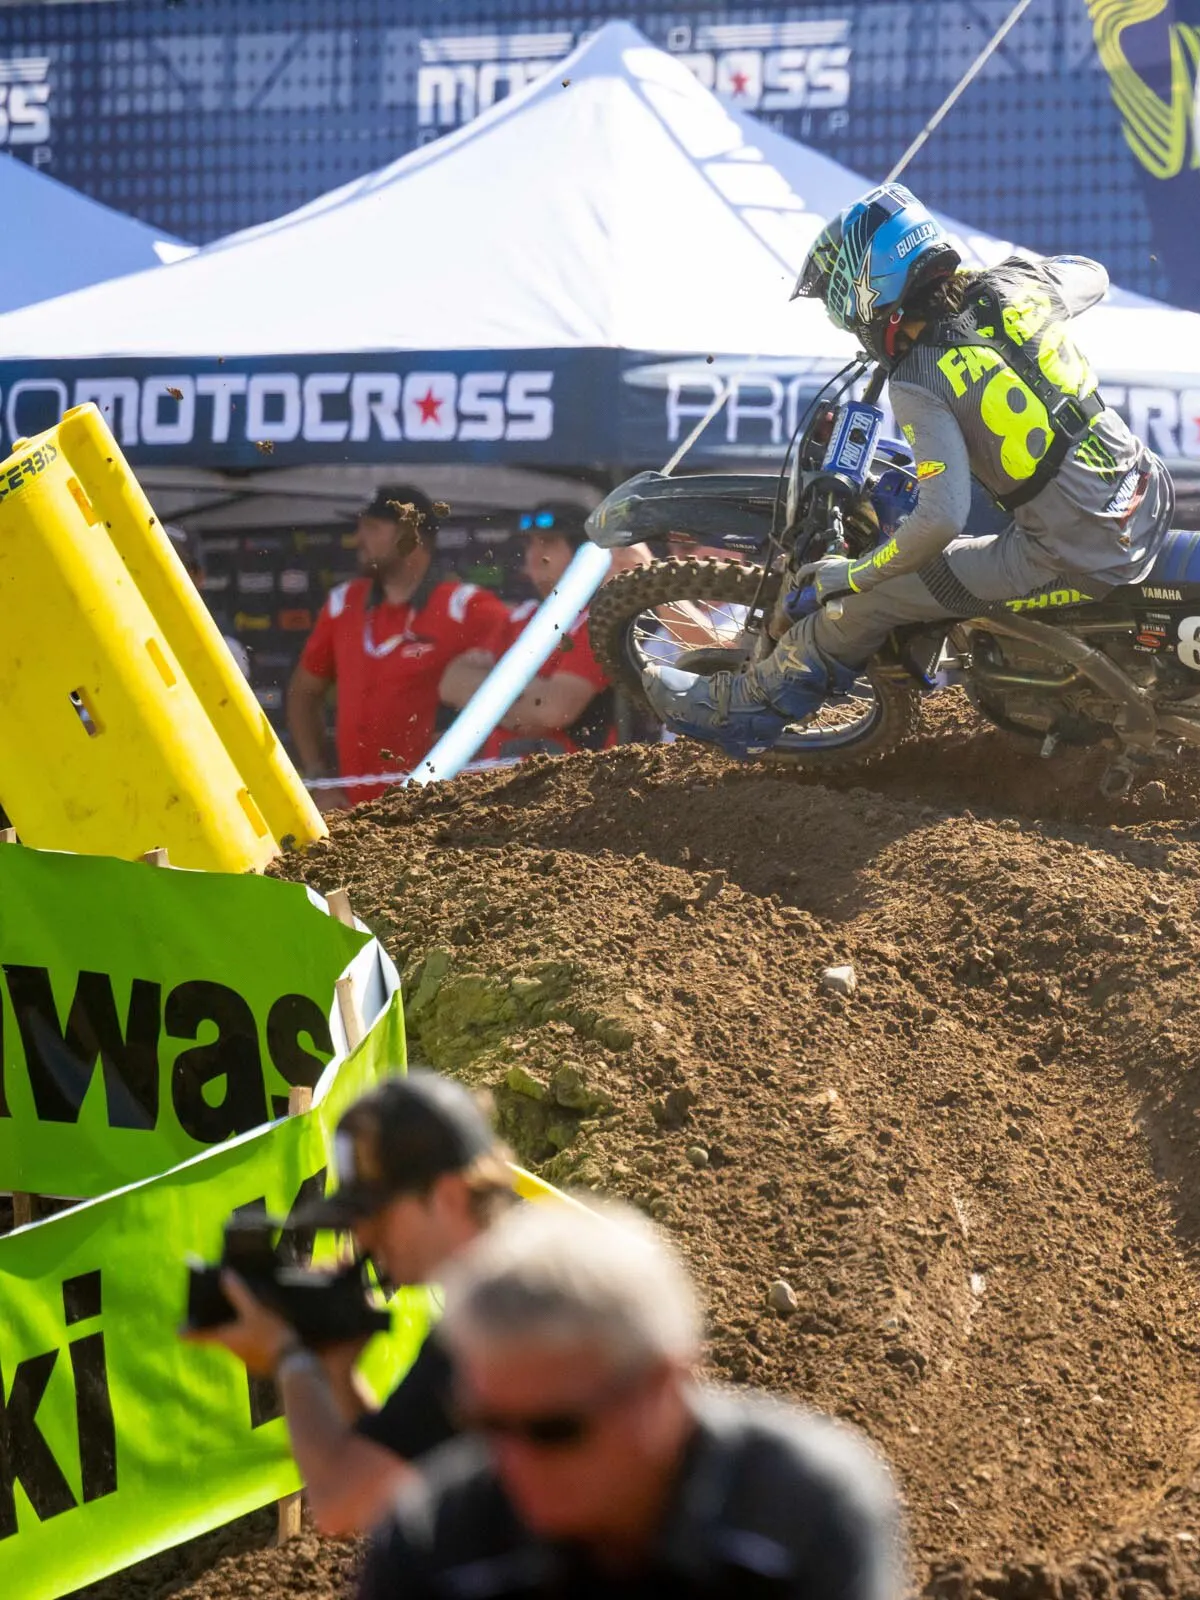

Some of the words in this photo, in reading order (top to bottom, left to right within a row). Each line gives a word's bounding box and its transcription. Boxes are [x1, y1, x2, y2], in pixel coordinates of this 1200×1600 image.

[896, 222, 938, 259] GUILLEM
[74, 370, 554, 446] MOTOCROSS
[1141, 587, 1182, 601] YAMAHA
[0, 964, 335, 1143] was
